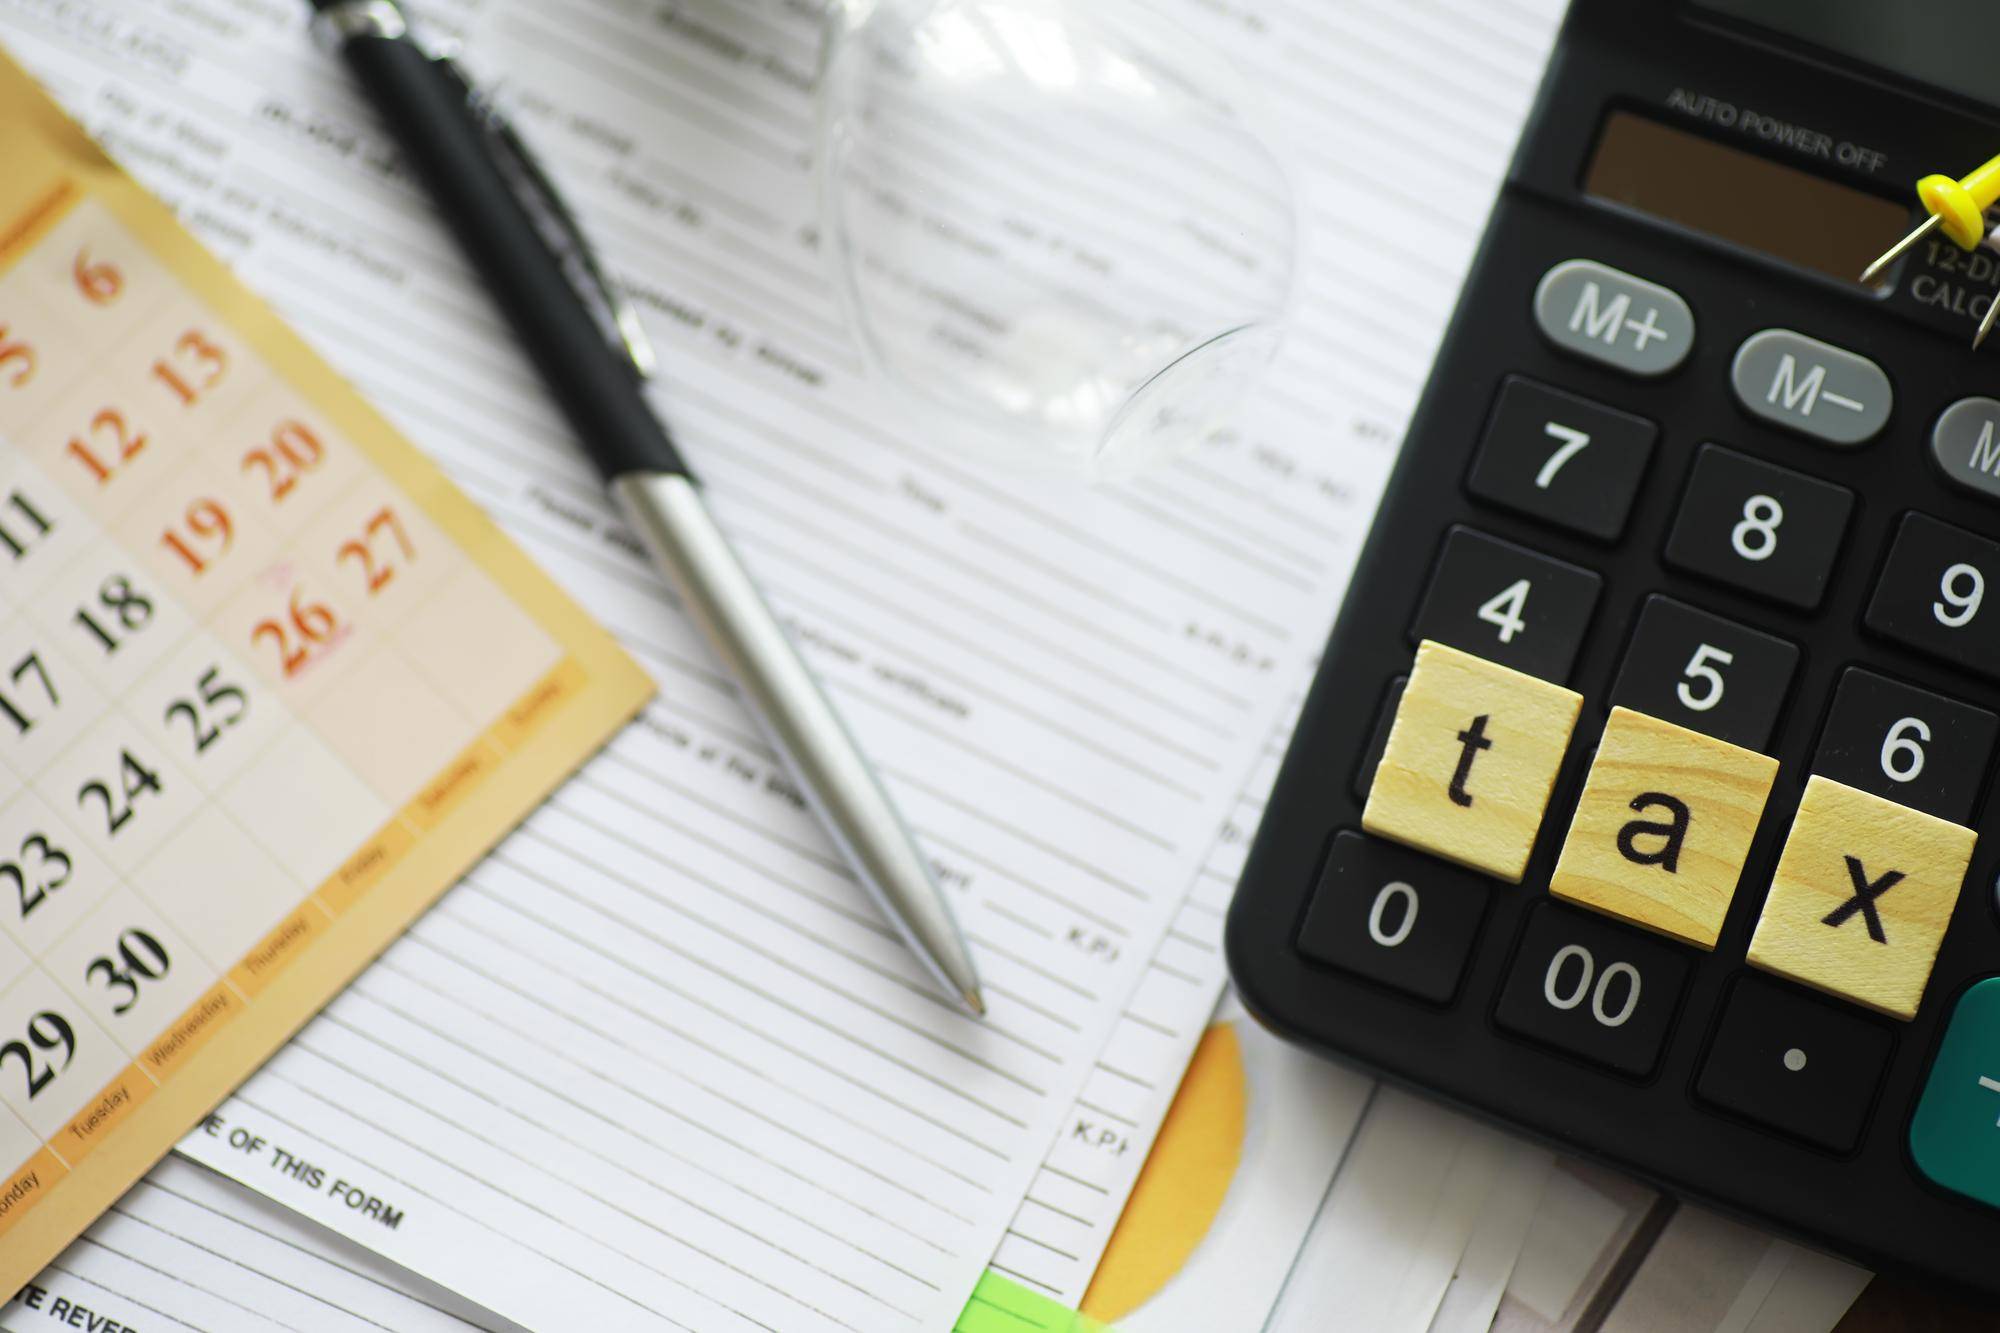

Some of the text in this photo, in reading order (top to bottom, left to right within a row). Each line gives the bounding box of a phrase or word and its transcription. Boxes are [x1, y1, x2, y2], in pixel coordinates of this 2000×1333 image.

[1667, 87, 1889, 173] AUTO POWER OFF
[73, 248, 125, 306] 6
[1568, 281, 1668, 352] M+
[66, 328, 227, 484] 12 13
[1535, 421, 1590, 489] 7
[160, 419, 325, 576] 19 20
[1731, 495, 1784, 561] 8
[73, 573, 154, 656] 18
[251, 507, 416, 676] 26 27
[1477, 579, 1531, 643] 4
[1932, 562, 1986, 628] 9
[1676, 643, 1734, 711] 5
[78, 665, 248, 835] 24 25
[1880, 716, 1932, 782] 6
[0, 832, 73, 918] 23
[1368, 881, 1419, 947] 0
[0, 927, 172, 1100] 29 30
[1544, 944, 1642, 1027] 00
[0, 1170, 41, 1219] onday
[69, 1083, 131, 1142] Tuesday
[148, 992, 228, 1068] Wednesday
[228, 1127, 266, 1154] OF
[270, 1147, 326, 1190] THIS
[327, 1179, 405, 1231] FORM
